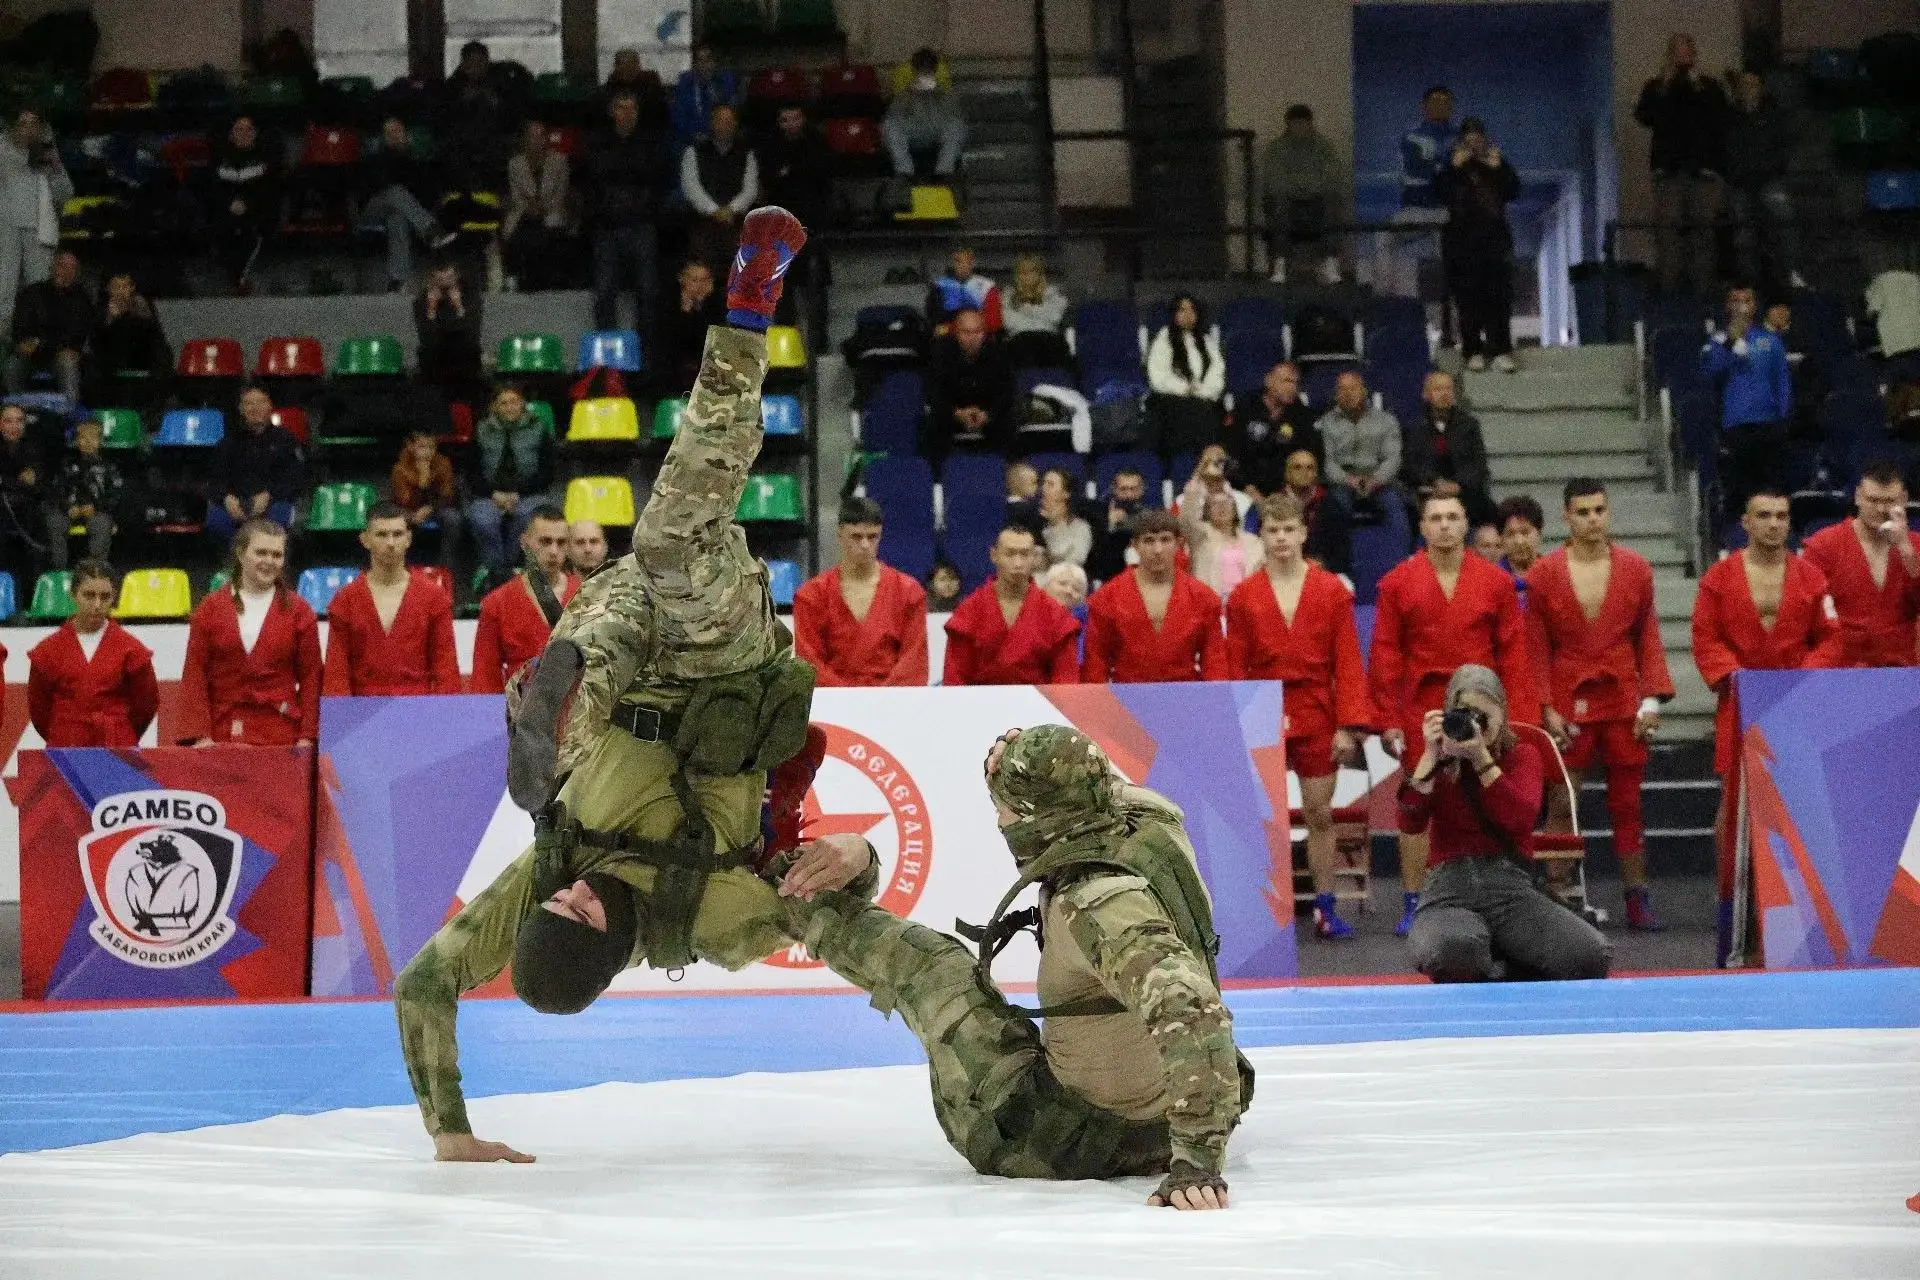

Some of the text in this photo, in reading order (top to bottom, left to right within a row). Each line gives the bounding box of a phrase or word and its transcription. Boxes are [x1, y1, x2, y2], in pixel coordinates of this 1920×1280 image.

[99, 798, 218, 829] САМБО
[97, 921, 228, 964] ХАБАРОВСКИЙ КРАЙ
